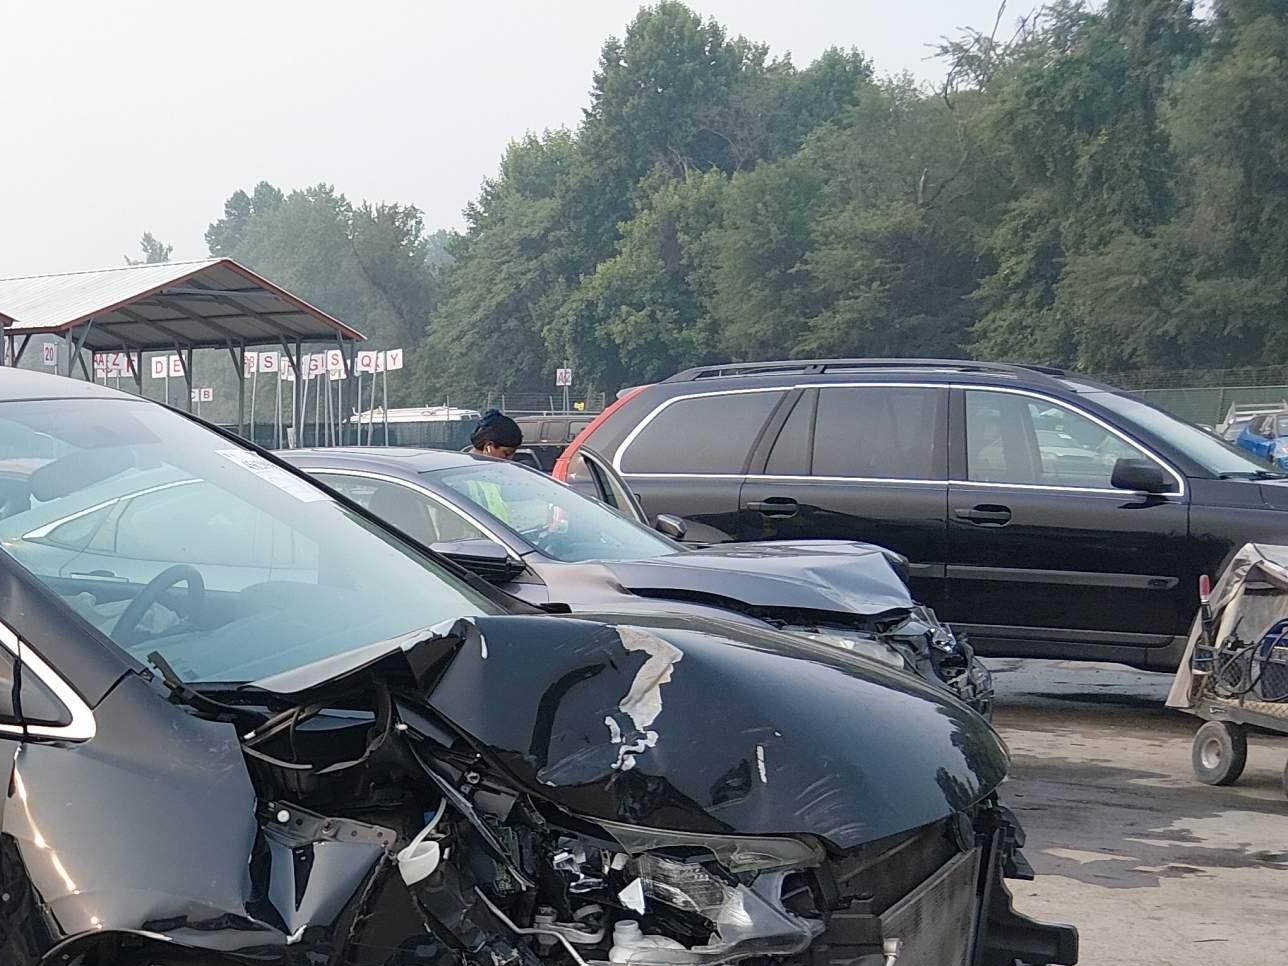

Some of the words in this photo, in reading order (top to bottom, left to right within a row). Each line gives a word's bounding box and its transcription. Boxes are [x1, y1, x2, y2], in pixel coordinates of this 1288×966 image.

[45, 347, 54, 361] 20
[330, 353, 340, 366] S
[390, 353, 398, 366] Y
[155, 361, 164, 374] D
[173, 360, 182, 373] E
[264, 356, 273, 368] S
[361, 354, 372, 368] Q
